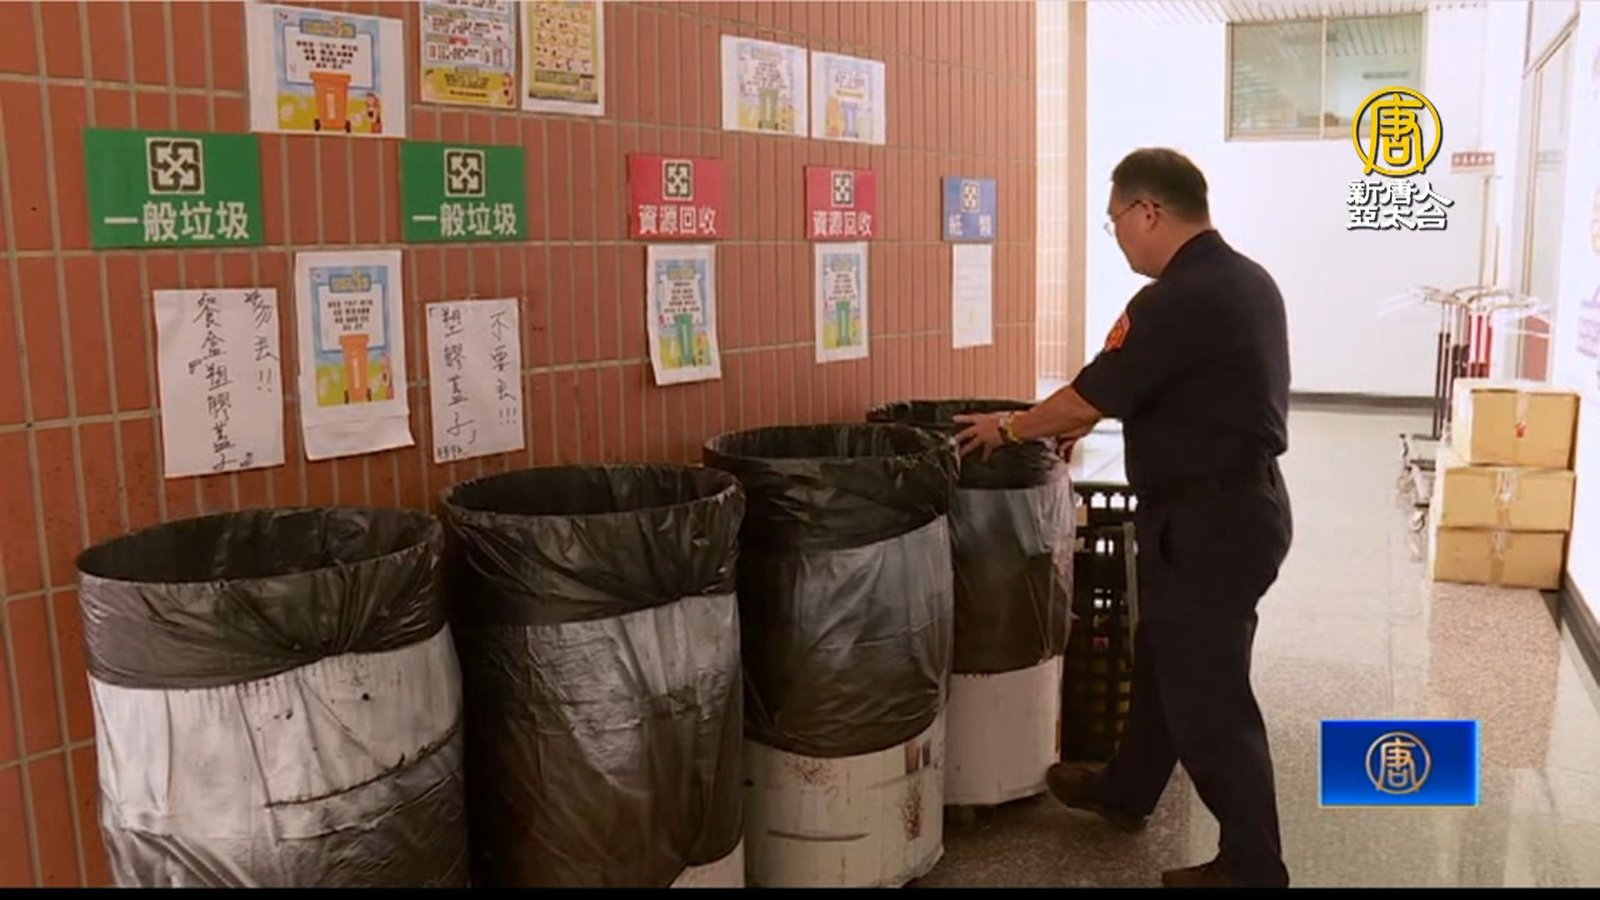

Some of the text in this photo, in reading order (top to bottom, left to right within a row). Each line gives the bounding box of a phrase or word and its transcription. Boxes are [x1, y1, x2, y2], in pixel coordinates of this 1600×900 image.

[103, 200, 250, 242] 一般垃圾
[411, 202, 518, 237] 一般垃圾
[638, 204, 717, 236] 資源回收
[812, 210, 873, 237] 資源回收
